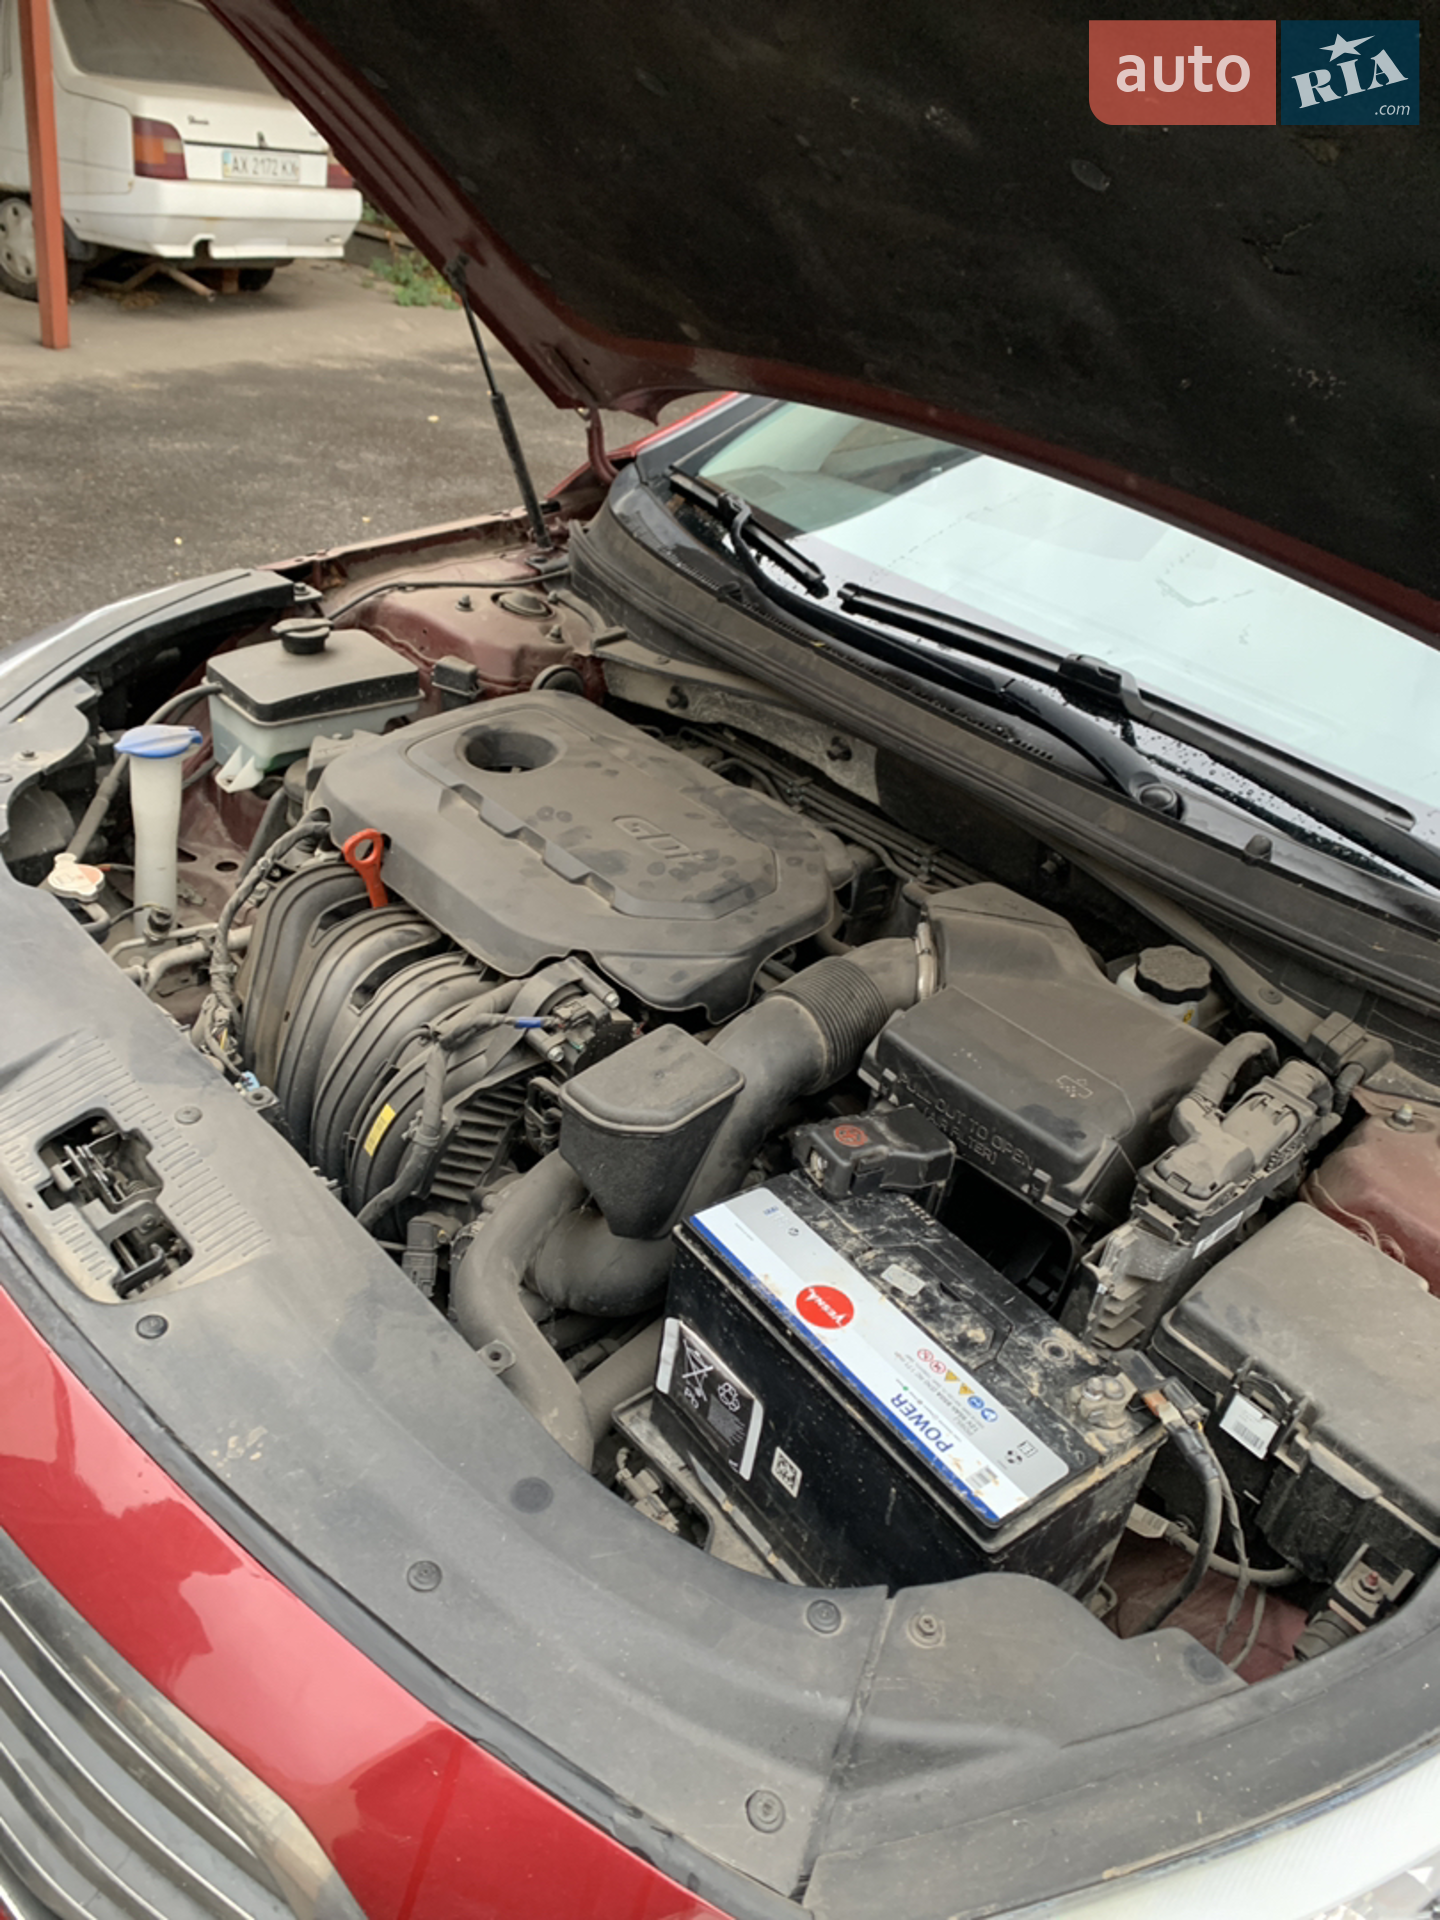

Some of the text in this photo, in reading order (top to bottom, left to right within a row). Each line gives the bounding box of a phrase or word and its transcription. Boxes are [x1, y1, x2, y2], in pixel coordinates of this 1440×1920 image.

[232, 156, 250, 174] AX
[253, 157, 278, 176] 2172
[934, 1098, 967, 1125] OUT
[969, 1117, 989, 1141] TO
[991, 1134, 1034, 1171] OPEN
[804, 1287, 846, 1327] VESNA
[890, 1393, 954, 1453] POWER
